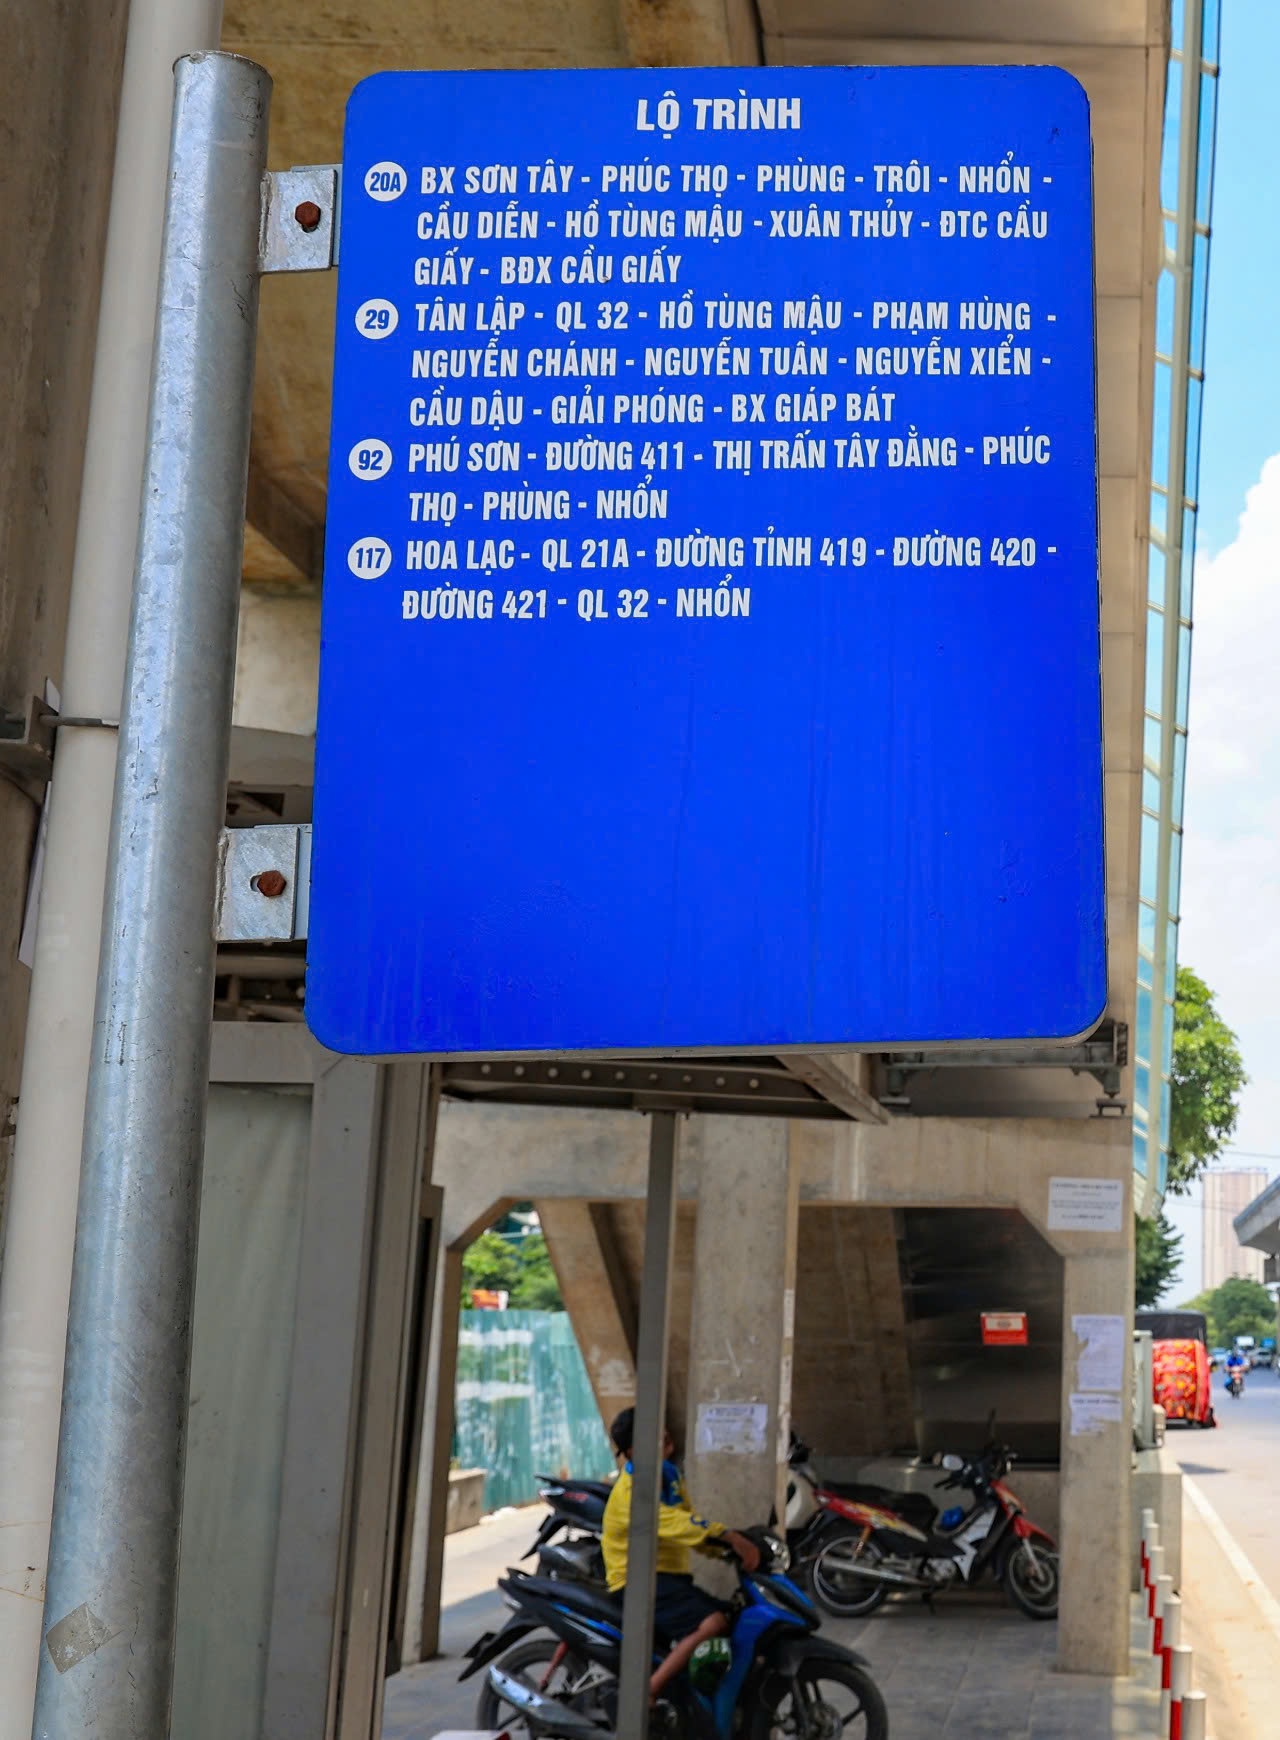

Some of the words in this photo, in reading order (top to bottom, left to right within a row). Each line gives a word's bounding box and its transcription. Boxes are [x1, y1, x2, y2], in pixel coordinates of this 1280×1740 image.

[637, 91, 679, 139] LỘ
[693, 90, 800, 130] TRÌNH
[369, 172, 401, 192] 20A
[421, 167, 455, 193] BX
[465, 164, 517, 193] SƠN
[527, 159, 573, 192] TÂY
[602, 157, 670, 192] PHÚC
[681, 165, 727, 197] THỌ
[758, 157, 844, 192] PHÙNG
[874, 160, 929, 192] TRÔI
[960, 151, 1029, 193] NHỔN
[418, 201, 468, 239] CẦU
[478, 201, 538, 238] DIỄN
[566, 199, 598, 237] HỒ
[609, 203, 675, 237] TÙNG
[685, 204, 742, 243] MẬU
[770, 204, 840, 237] XUÂN
[849, 199, 912, 237] THỦY
[940, 211, 987, 238] ĐTC
[998, 200, 1047, 238] CẦU
[415, 247, 474, 285] GIẤY
[501, 257, 552, 284] BĐX
[562, 244, 612, 284] CẦU
[622, 246, 681, 283] GIẤY
[364, 309, 390, 330] 29
[416, 297, 465, 331] TÂN
[477, 296, 524, 335] LẬP
[557, 302, 586, 332] QL
[598, 302, 628, 329] 32
[660, 290, 693, 328] HỒ
[705, 293, 771, 328] TÙNG
[784, 295, 841, 335] MẬU
[873, 302, 948, 335] PHẠM
[960, 296, 1030, 330] HÙNG
[412, 338, 518, 378] NGUYỄN
[528, 341, 616, 376] CHÁNH
[645, 337, 750, 376] NGUYỄN
[760, 341, 827, 375] TUÂN
[856, 337, 960, 375] NGUYỄN
[970, 334, 1030, 375] XIỂN
[410, 385, 462, 426] CẦU
[471, 390, 523, 431] DẬU
[552, 385, 604, 424] GIẢI
[614, 387, 703, 423] PHÓNG
[732, 394, 765, 422] BX
[776, 387, 836, 422] GIÁP
[847, 386, 895, 421] BÁT
[357, 449, 384, 471] 92
[409, 436, 460, 472] PHÚ
[467, 440, 519, 471] SƠN
[546, 434, 632, 470] ĐƯỜNG
[641, 442, 683, 469] 411
[713, 441, 751, 475] THỊ
[760, 430, 825, 468] TRẤN
[834, 432, 879, 467] TÂY
[887, 425, 956, 467] ĐẰNG
[983, 427, 1050, 464] PHÚC
[410, 492, 456, 526] THỌ
[483, 481, 569, 520] PHÙNG
[597, 474, 667, 519] NHỔN
[354, 547, 386, 569] 117
[407, 540, 457, 569] HOA
[467, 540, 514, 575] LẠC
[543, 539, 572, 571] QL
[581, 539, 628, 568] 21A
[656, 528, 743, 567] ĐƯỜNG
[753, 526, 811, 566] TỈNH
[820, 538, 866, 566] 419
[893, 529, 980, 566] ĐƯỜNG
[991, 538, 1035, 566] 420
[402, 582, 493, 619] ĐƯỜNG
[502, 590, 546, 618] 421
[578, 589, 608, 621] QL
[617, 589, 648, 618] 32
[677, 574, 750, 617] NHỔN
